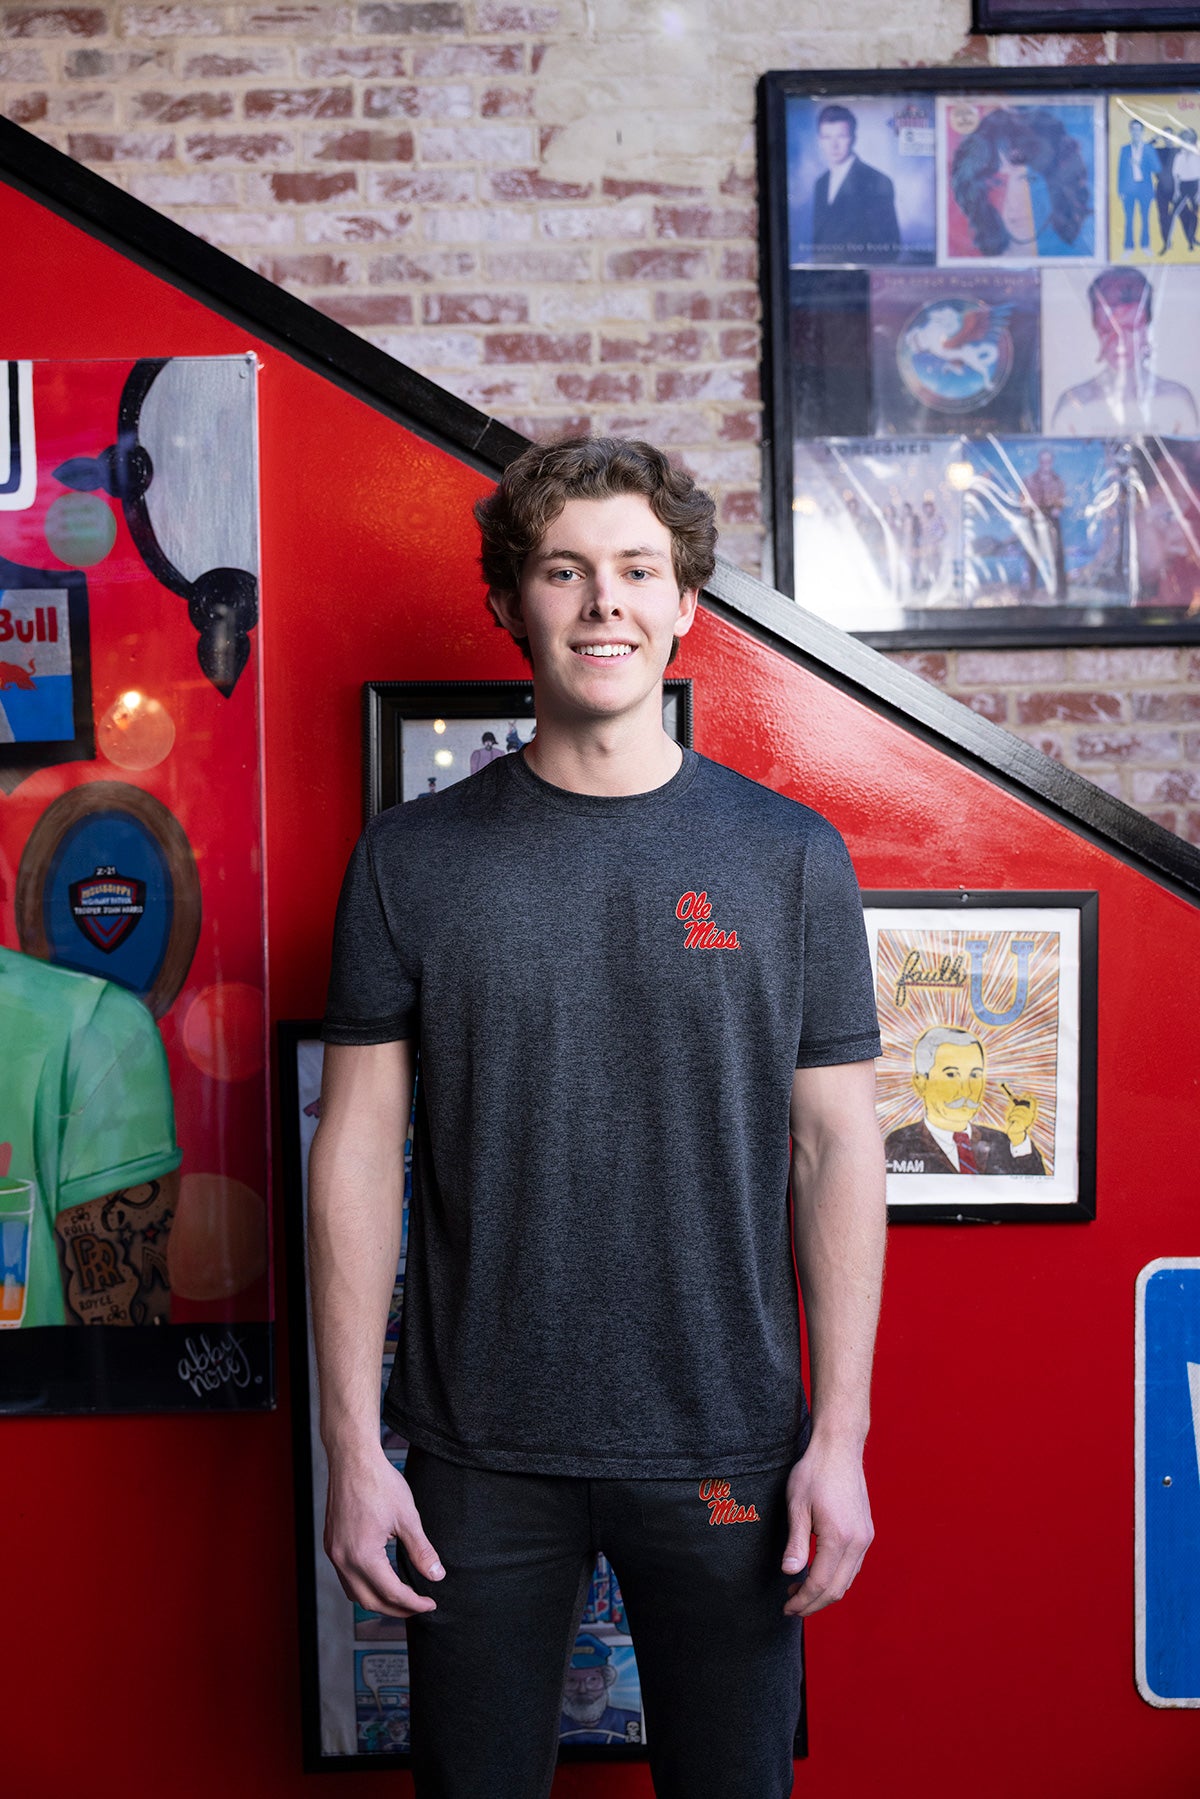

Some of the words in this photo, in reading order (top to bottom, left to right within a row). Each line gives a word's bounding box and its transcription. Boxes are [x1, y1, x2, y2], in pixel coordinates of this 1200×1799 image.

[0, 605, 58, 644] Bull
[675, 890, 712, 920] Ole
[684, 920, 740, 950] Miss
[699, 1479, 731, 1501] Ole
[707, 1498, 759, 1526] Miss
